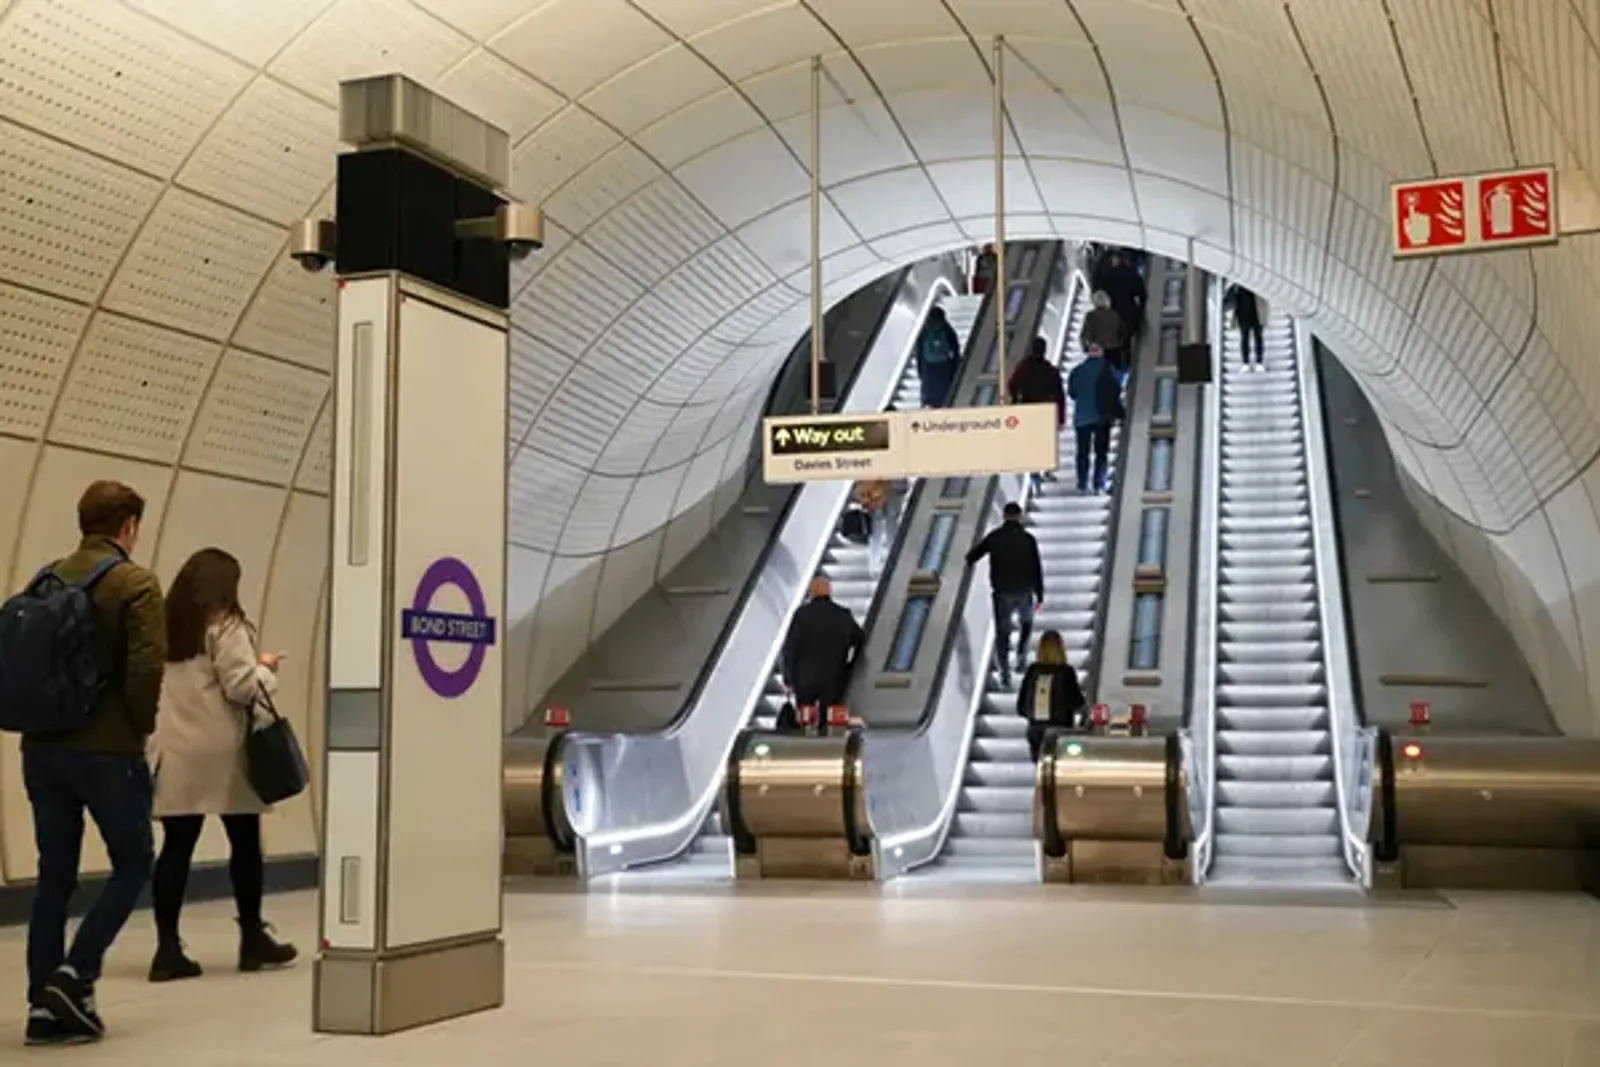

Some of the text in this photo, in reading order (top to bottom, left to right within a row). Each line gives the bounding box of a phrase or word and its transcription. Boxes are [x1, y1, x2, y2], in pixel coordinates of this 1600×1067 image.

[923, 418, 1001, 432] Underground
[793, 426, 865, 447] Way out
[795, 458, 871, 470] Davies Street
[411, 616, 486, 638] BOND STREET
